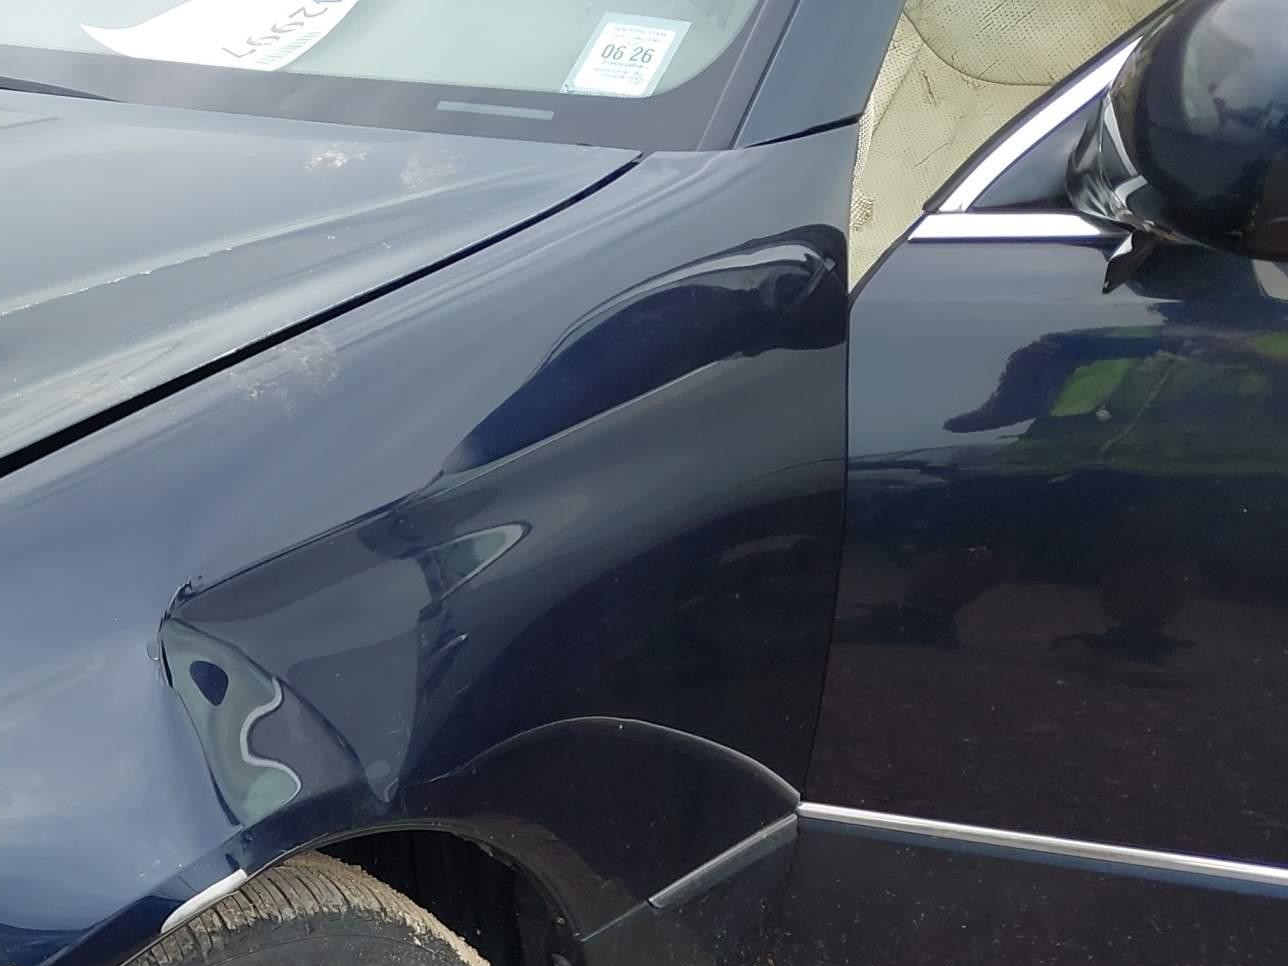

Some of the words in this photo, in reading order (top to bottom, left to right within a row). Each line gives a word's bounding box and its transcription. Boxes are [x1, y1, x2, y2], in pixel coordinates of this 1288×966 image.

[221, 0, 344, 58] 2997
[601, 44, 627, 60] 06
[630, 46, 655, 63] 26
